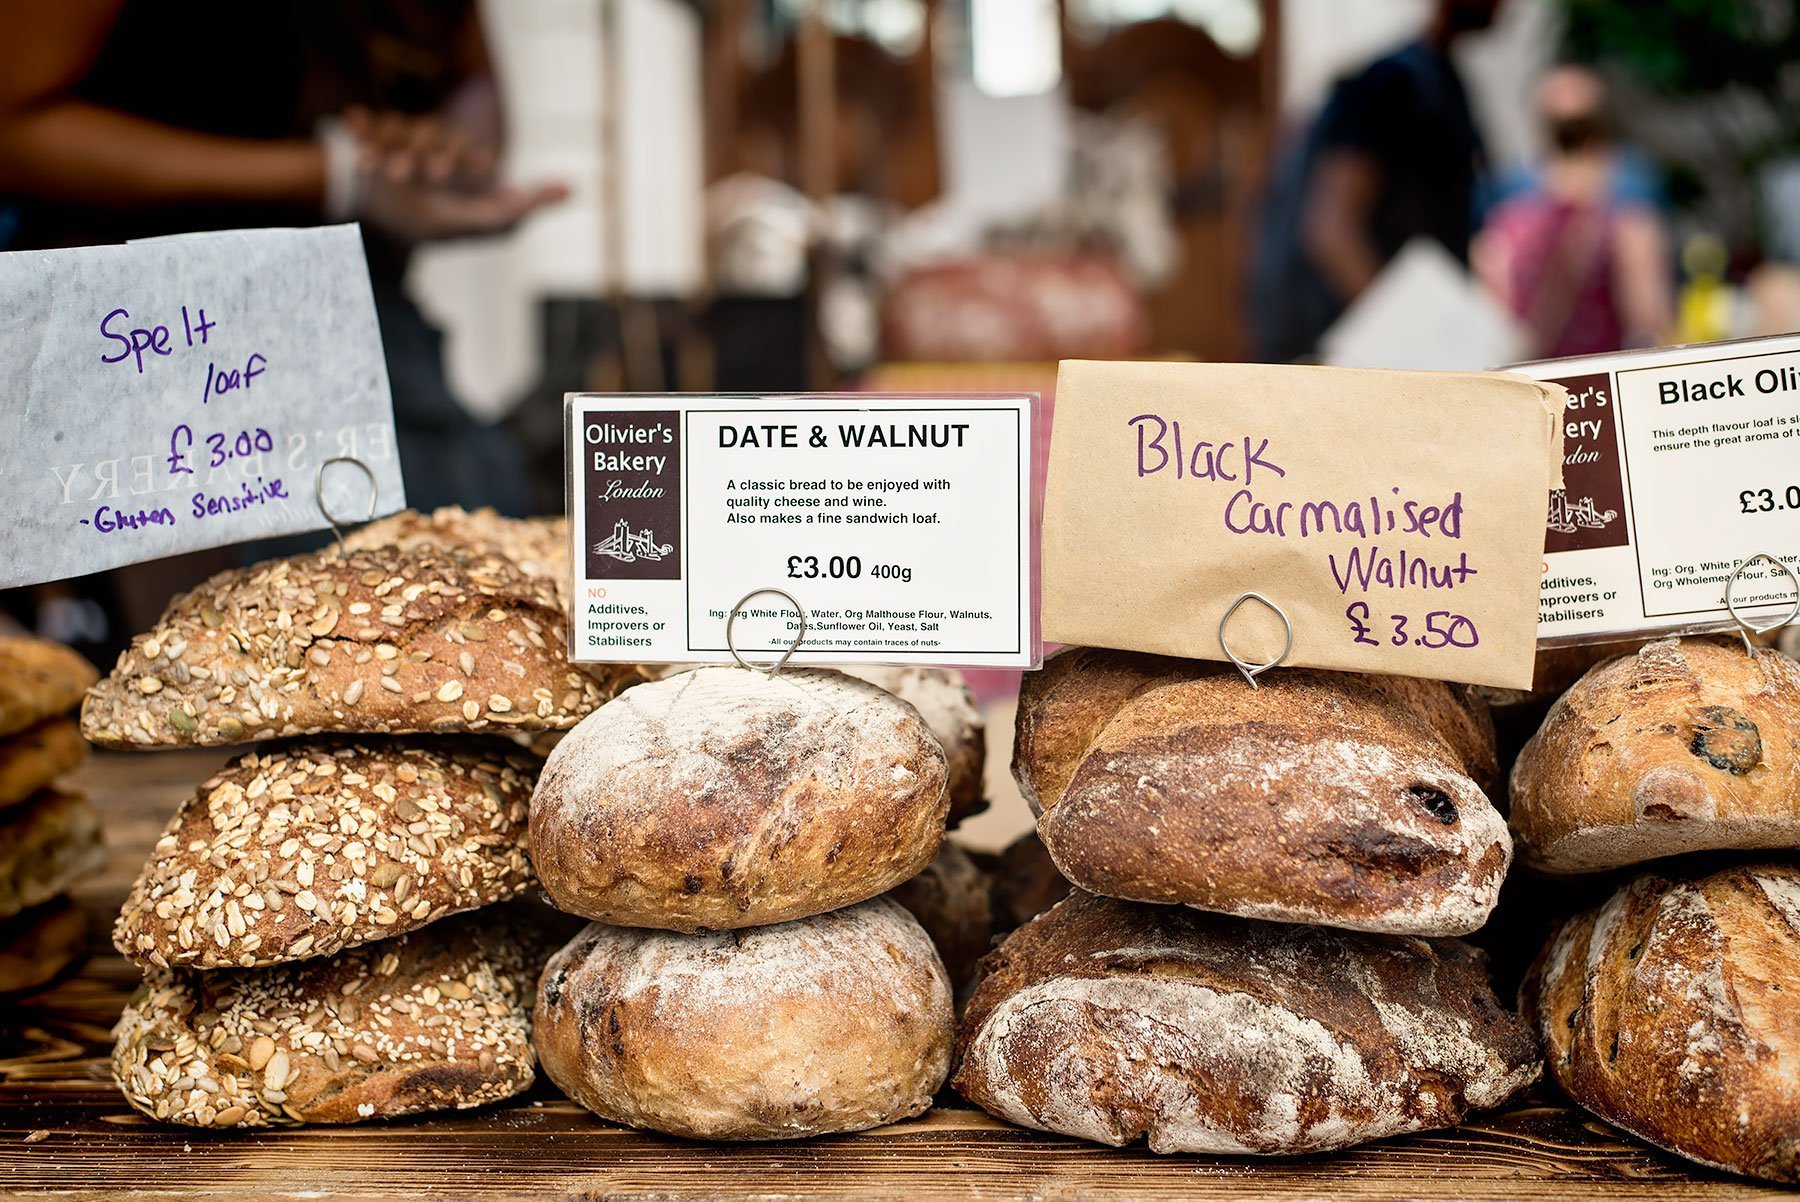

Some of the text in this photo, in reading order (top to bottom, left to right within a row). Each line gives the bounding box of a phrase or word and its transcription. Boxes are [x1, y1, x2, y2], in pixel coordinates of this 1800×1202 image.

[100, 305, 216, 373] Spelt
[203, 353, 267, 404] loaf
[1658, 367, 1800, 405] Black Oli
[1566, 386, 1607, 410] er's
[585, 423, 673, 444] Olivier's
[718, 424, 970, 448] DATE & WALNUT
[1565, 419, 1602, 440] ery
[1652, 414, 1800, 439] This depth flavour loaf is sl
[1127, 413, 1286, 485] Black
[1653, 441, 1691, 453] ensure
[1693, 439, 1711, 448] the
[1713, 435, 1742, 448] great
[1744, 431, 1780, 443] aroma
[1782, 428, 1793, 438] of
[594, 450, 667, 475] Bakery
[1564, 444, 1604, 465] don
[598, 479, 667, 502] London
[726, 479, 951, 493] A classic bread to be enjoyed with
[726, 496, 887, 509] quality cheese and wine.
[1739, 485, 1800, 514] £3.0
[726, 512, 941, 524] Also makes a fine sandwich loaf.
[787, 555, 912, 583] £3.00 400g
[1328, 546, 1478, 594] Walnut
[1652, 567, 1672, 578] Ing:
[1674, 564, 1697, 575] Org.
[1700, 561, 1730, 571] White
[1540, 576, 1597, 590] dditives,
[1653, 579, 1673, 589] Org
[1675, 573, 1732, 587] Wholemea
[1737, 570, 1768, 581] Flour,
[588, 587, 607, 599] NO
[1539, 590, 1617, 608] mprovers or
[1732, 596, 1747, 604] our
[1749, 591, 1788, 603] products
[588, 604, 648, 616] Additives,
[709, 609, 727, 619] Ing:
[750, 609, 778, 618] White
[780, 609, 808, 619] Flou,
[811, 609, 842, 619] Water,
[844, 609, 863, 620] Org
[865, 609, 916, 619] Malthouse
[919, 610, 947, 620] Flour,
[949, 610, 993, 620] Walnuts,
[1537, 608, 1604, 623] Stabilisers
[588, 620, 665, 635] Improvers or
[868, 622, 885, 632] Oil,
[888, 622, 918, 632] Yeast,
[920, 622, 940, 631] Salt
[588, 635, 652, 647] Stabilisers
[835, 639, 852, 647] may
